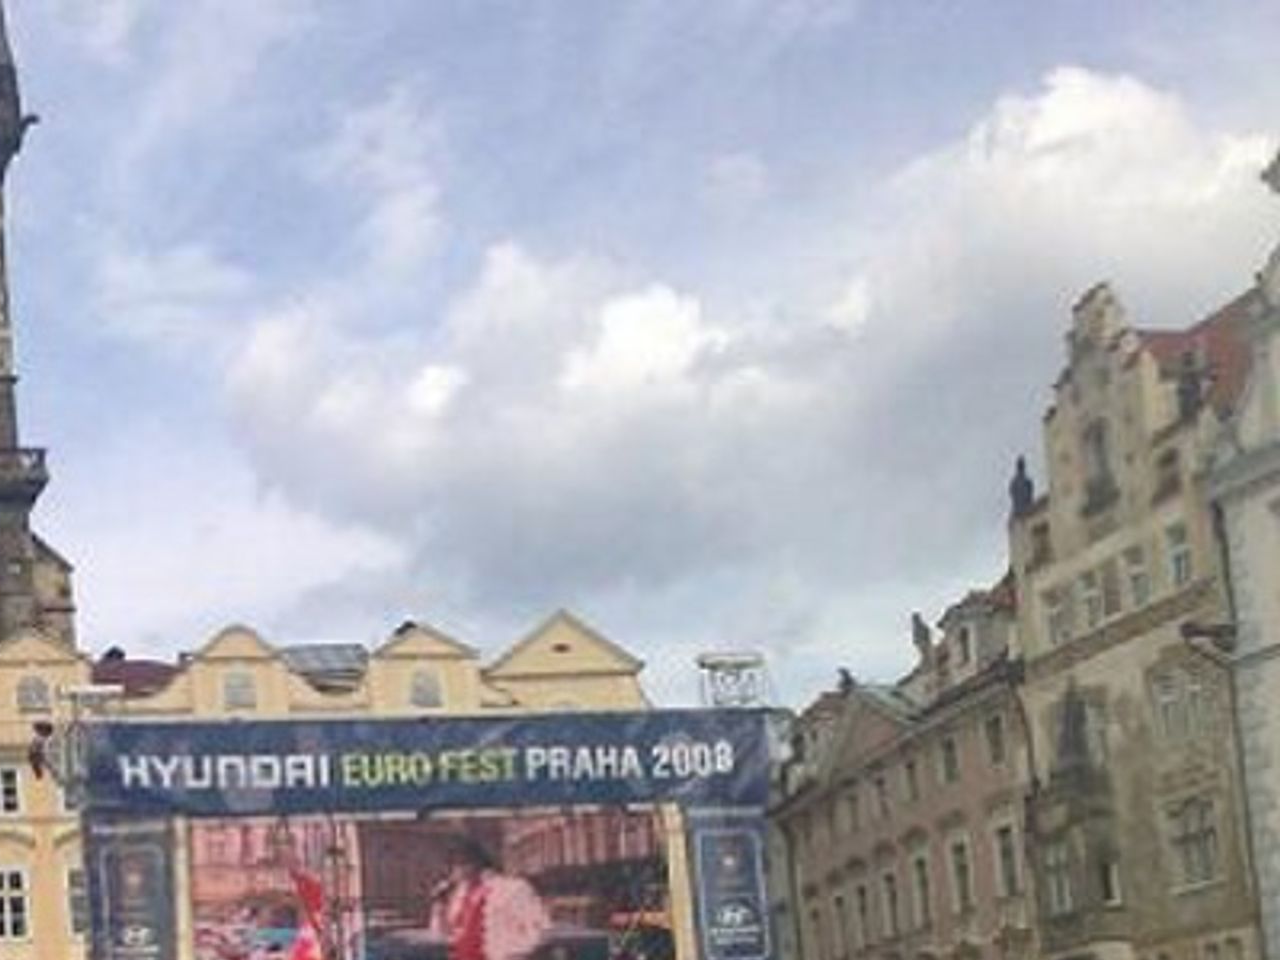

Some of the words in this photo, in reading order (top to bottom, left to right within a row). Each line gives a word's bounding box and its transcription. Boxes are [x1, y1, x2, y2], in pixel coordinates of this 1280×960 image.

[119, 753, 331, 789] HYUNDAI
[341, 751, 432, 787] EURO
[438, 748, 516, 784] FEST
[525, 744, 643, 781] PRAHA
